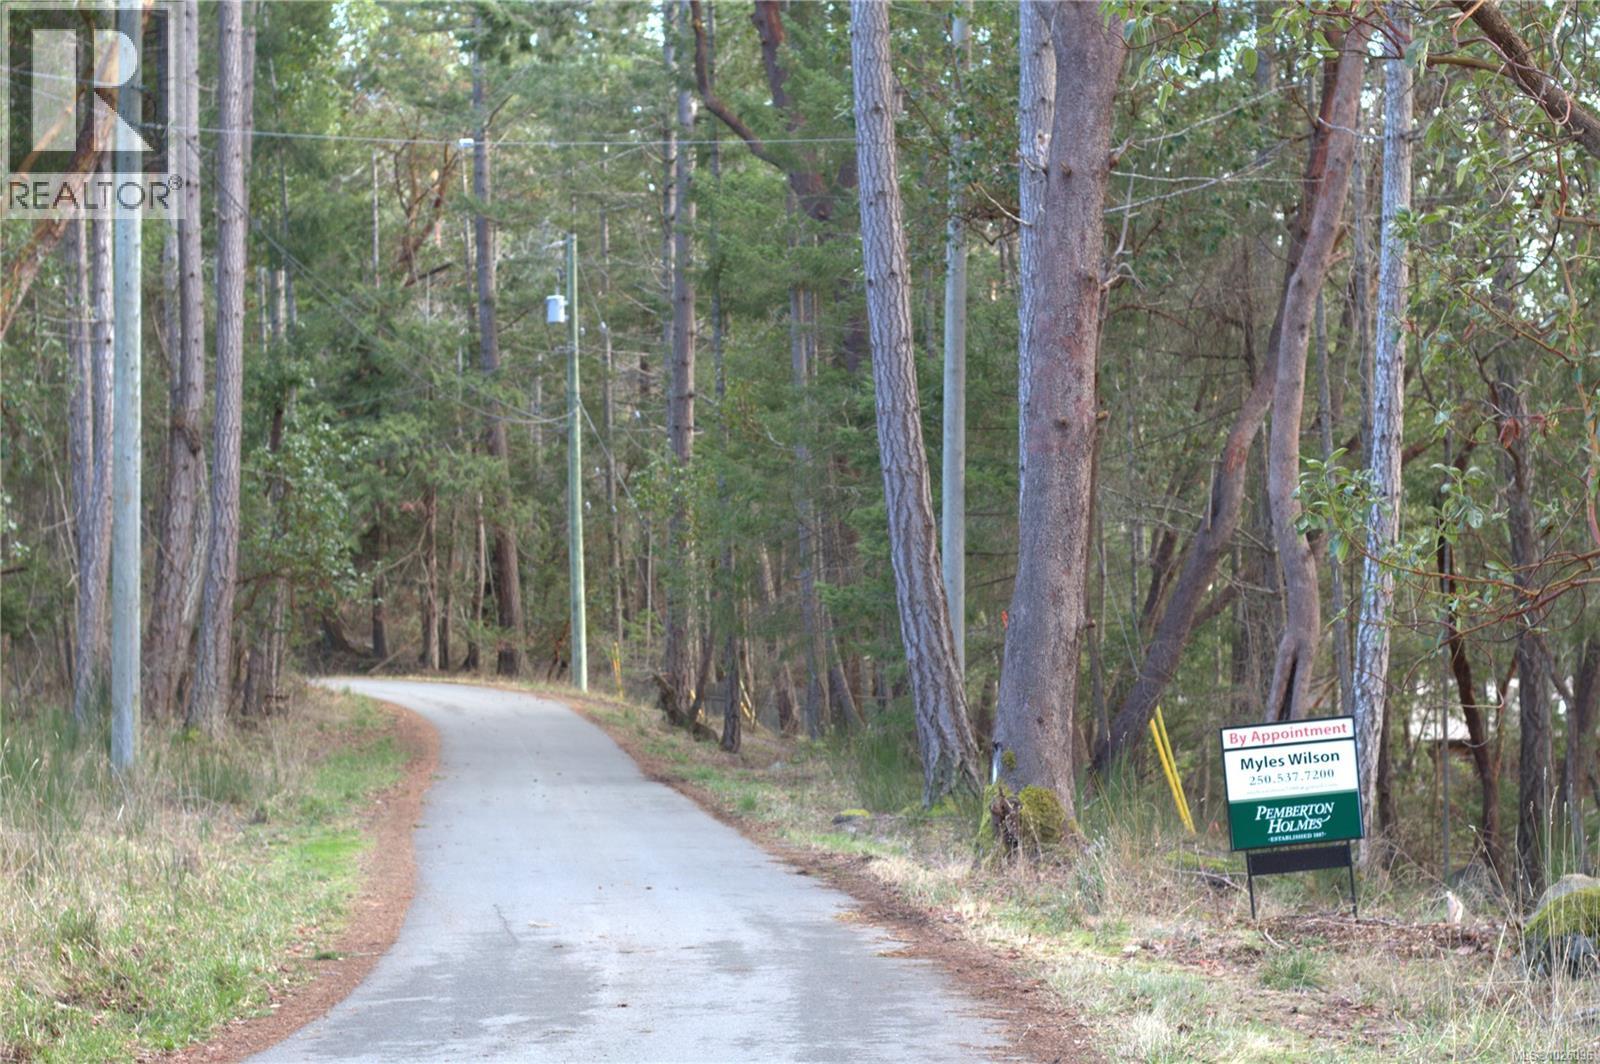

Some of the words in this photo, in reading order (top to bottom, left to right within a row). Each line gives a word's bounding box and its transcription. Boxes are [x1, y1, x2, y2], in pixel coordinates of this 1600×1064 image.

[1229, 732, 1247, 747] By
[1251, 723, 1347, 744] Appointment
[1240, 756, 1285, 772] Myles
[1288, 752, 1340, 766] Wilson
[1249, 769, 1335, 786] 250.537.7200
[1255, 802, 1335, 822] PEMBERTON
[1267, 818, 1323, 834] HOLMES
